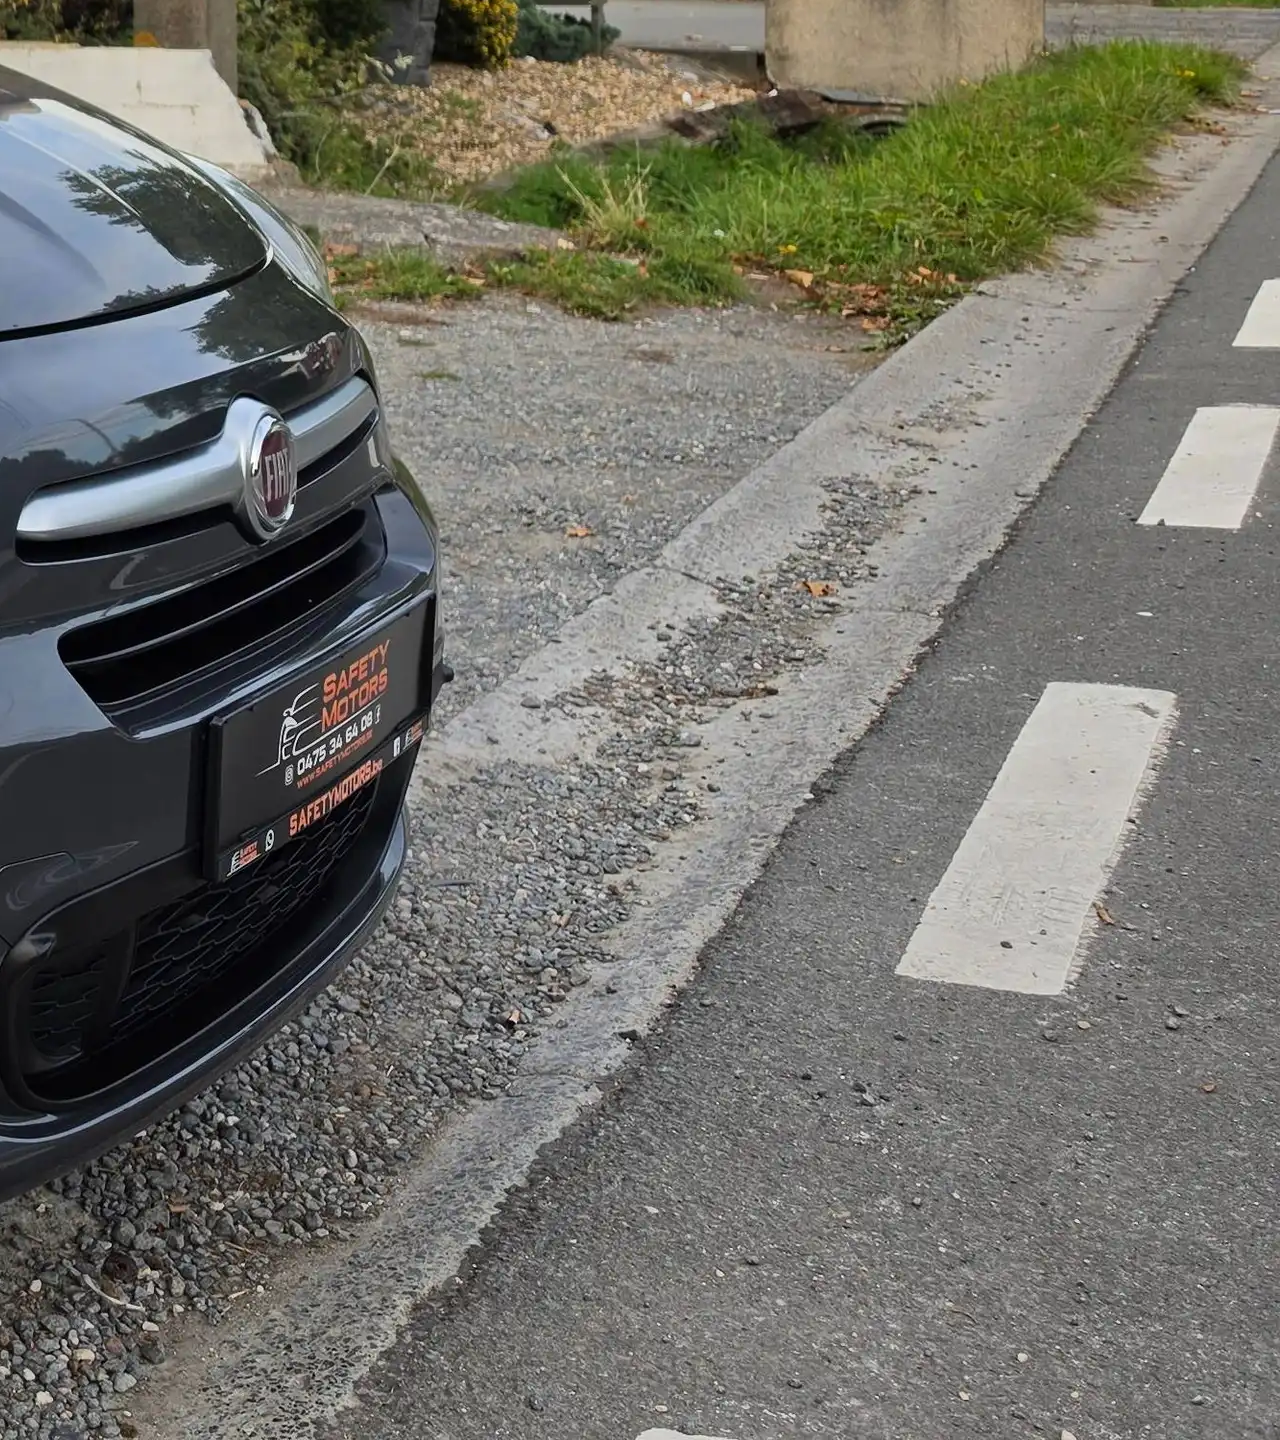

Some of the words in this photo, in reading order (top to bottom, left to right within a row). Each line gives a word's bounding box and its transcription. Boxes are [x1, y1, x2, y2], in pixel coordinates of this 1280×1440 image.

[264, 447, 290, 503] FIAT
[321, 667, 388, 733] MOTORS
[323, 639, 390, 704] SAFETY
[297, 743, 327, 776] 0475
[328, 733, 343, 756] 34
[345, 721, 359, 744] 64
